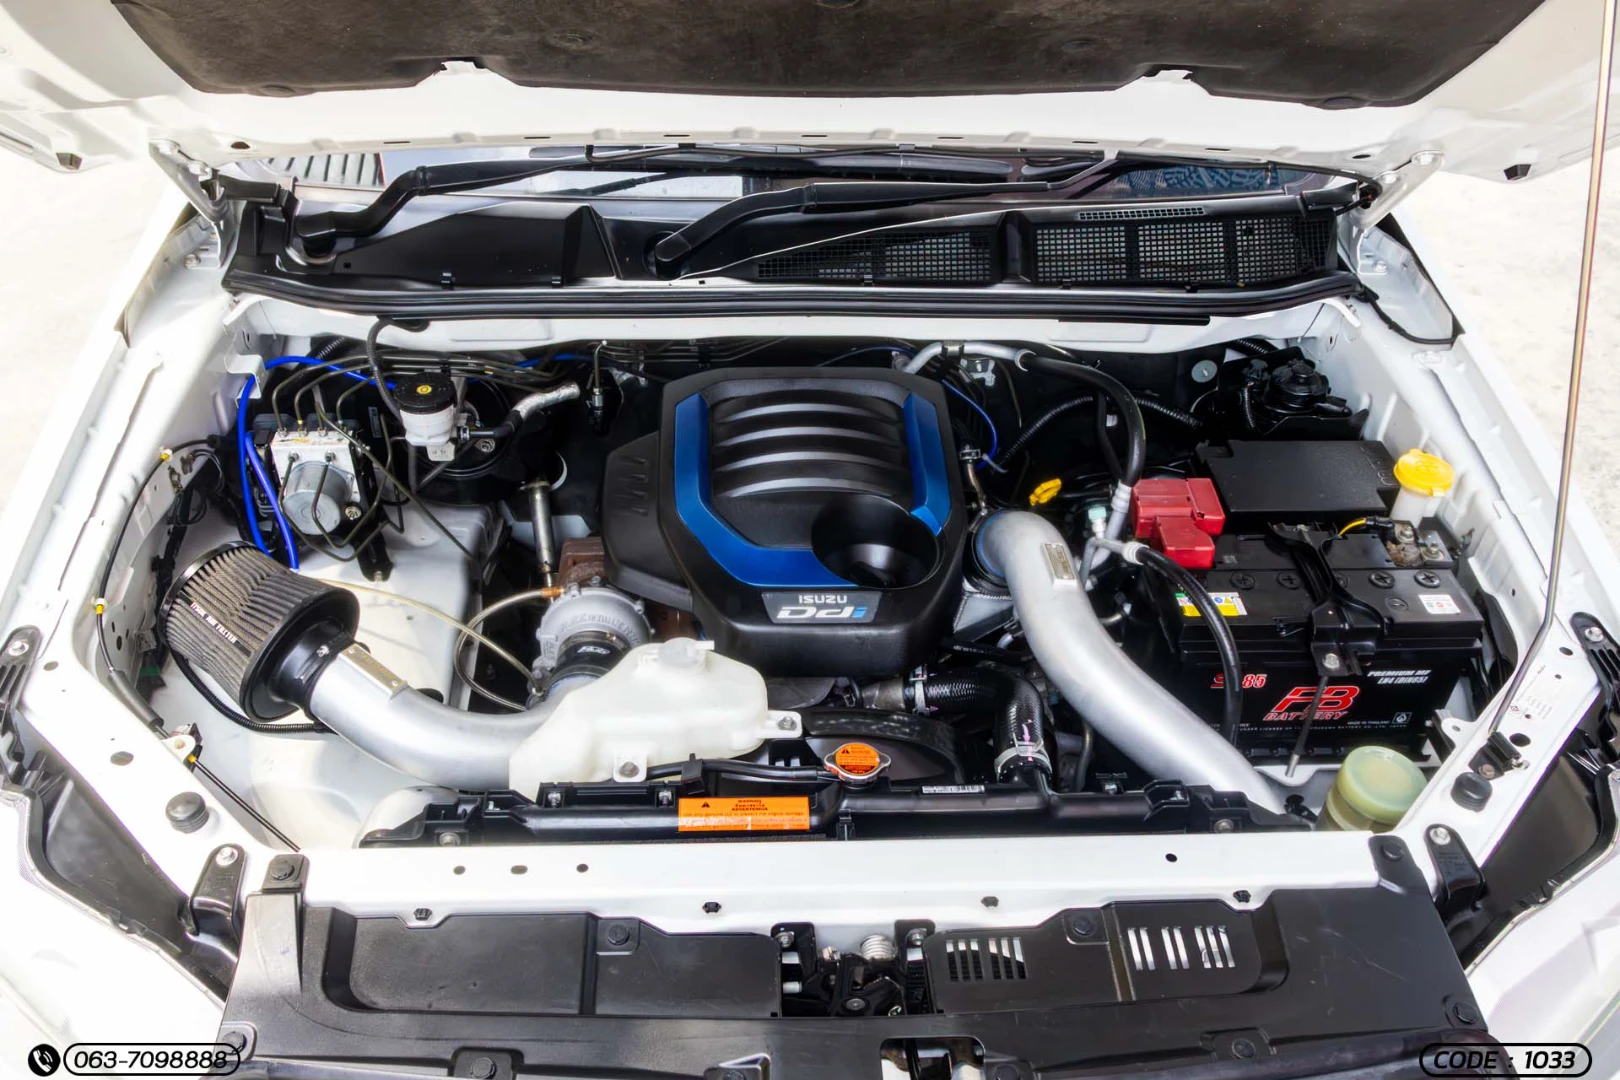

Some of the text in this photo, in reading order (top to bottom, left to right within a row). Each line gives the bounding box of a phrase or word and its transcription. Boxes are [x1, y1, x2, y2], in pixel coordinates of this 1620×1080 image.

[798, 595, 848, 604] ISUZU
[1242, 674, 1268, 689] 85
[1271, 686, 1360, 713] FB
[1262, 711, 1349, 721] BATTERY
